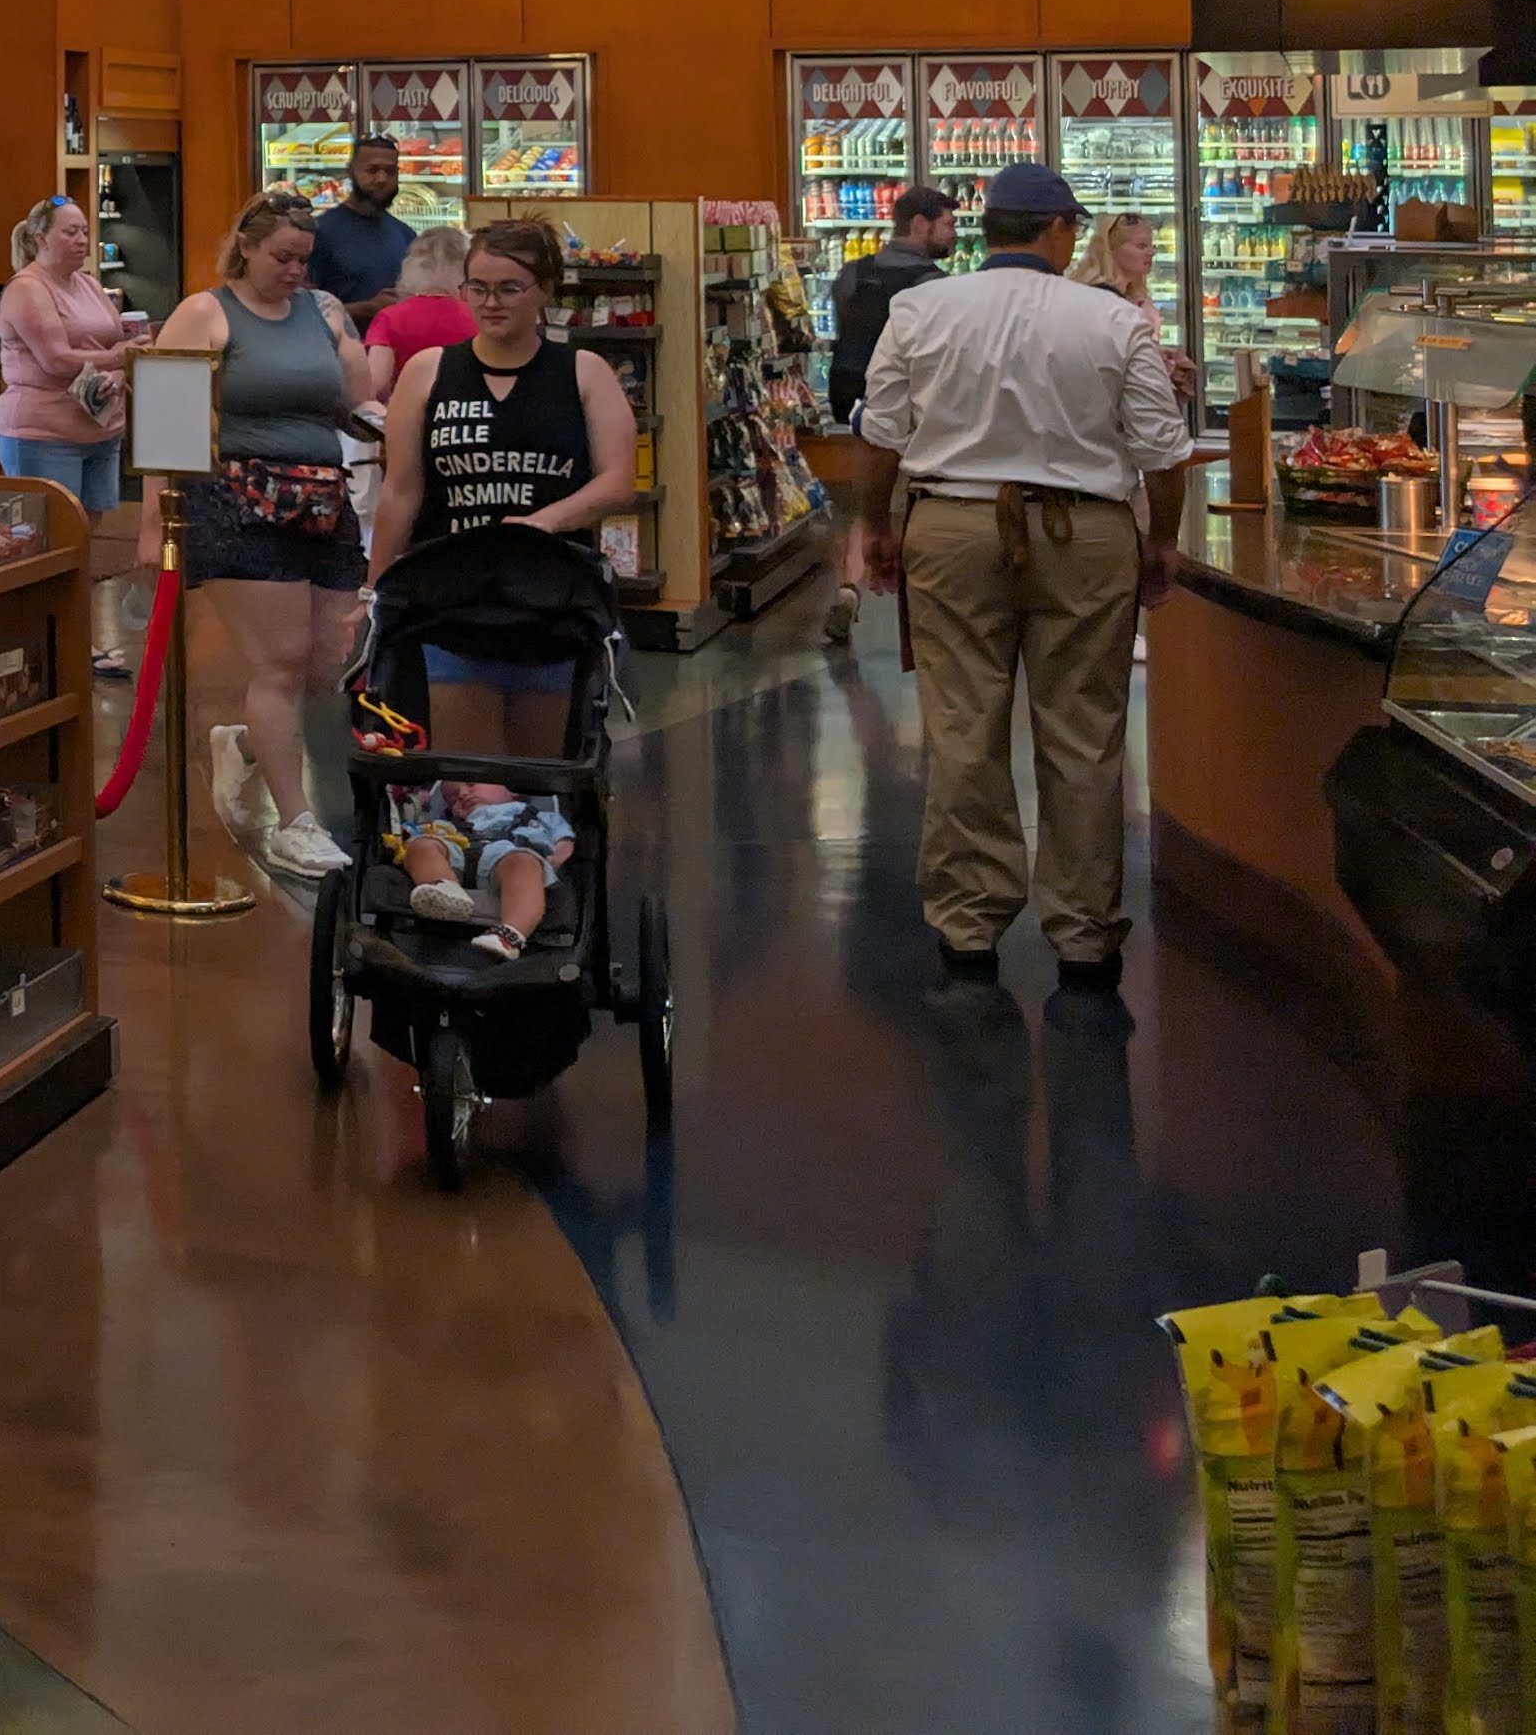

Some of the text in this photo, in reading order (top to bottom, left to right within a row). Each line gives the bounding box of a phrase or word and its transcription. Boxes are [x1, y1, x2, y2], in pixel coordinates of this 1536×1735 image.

[397, 87, 429, 107] TASTY
[498, 84, 559, 104] DELICIOUS
[812, 82, 895, 102] DELIGHTFUL
[943, 79, 1022, 102] FLAVORFUL
[1091, 78, 1140, 101] YUMMY
[1220, 76, 1294, 99] EXQUISITE
[266, 91, 343, 111] SCRUMPTIOUS
[433, 400, 494, 422] ARIEL
[430, 425, 490, 449] BELLE
[434, 450, 574, 479] CINDERELLA
[447, 482, 534, 508] JASMINE
[1228, 1480, 1274, 1492] Nutrit
